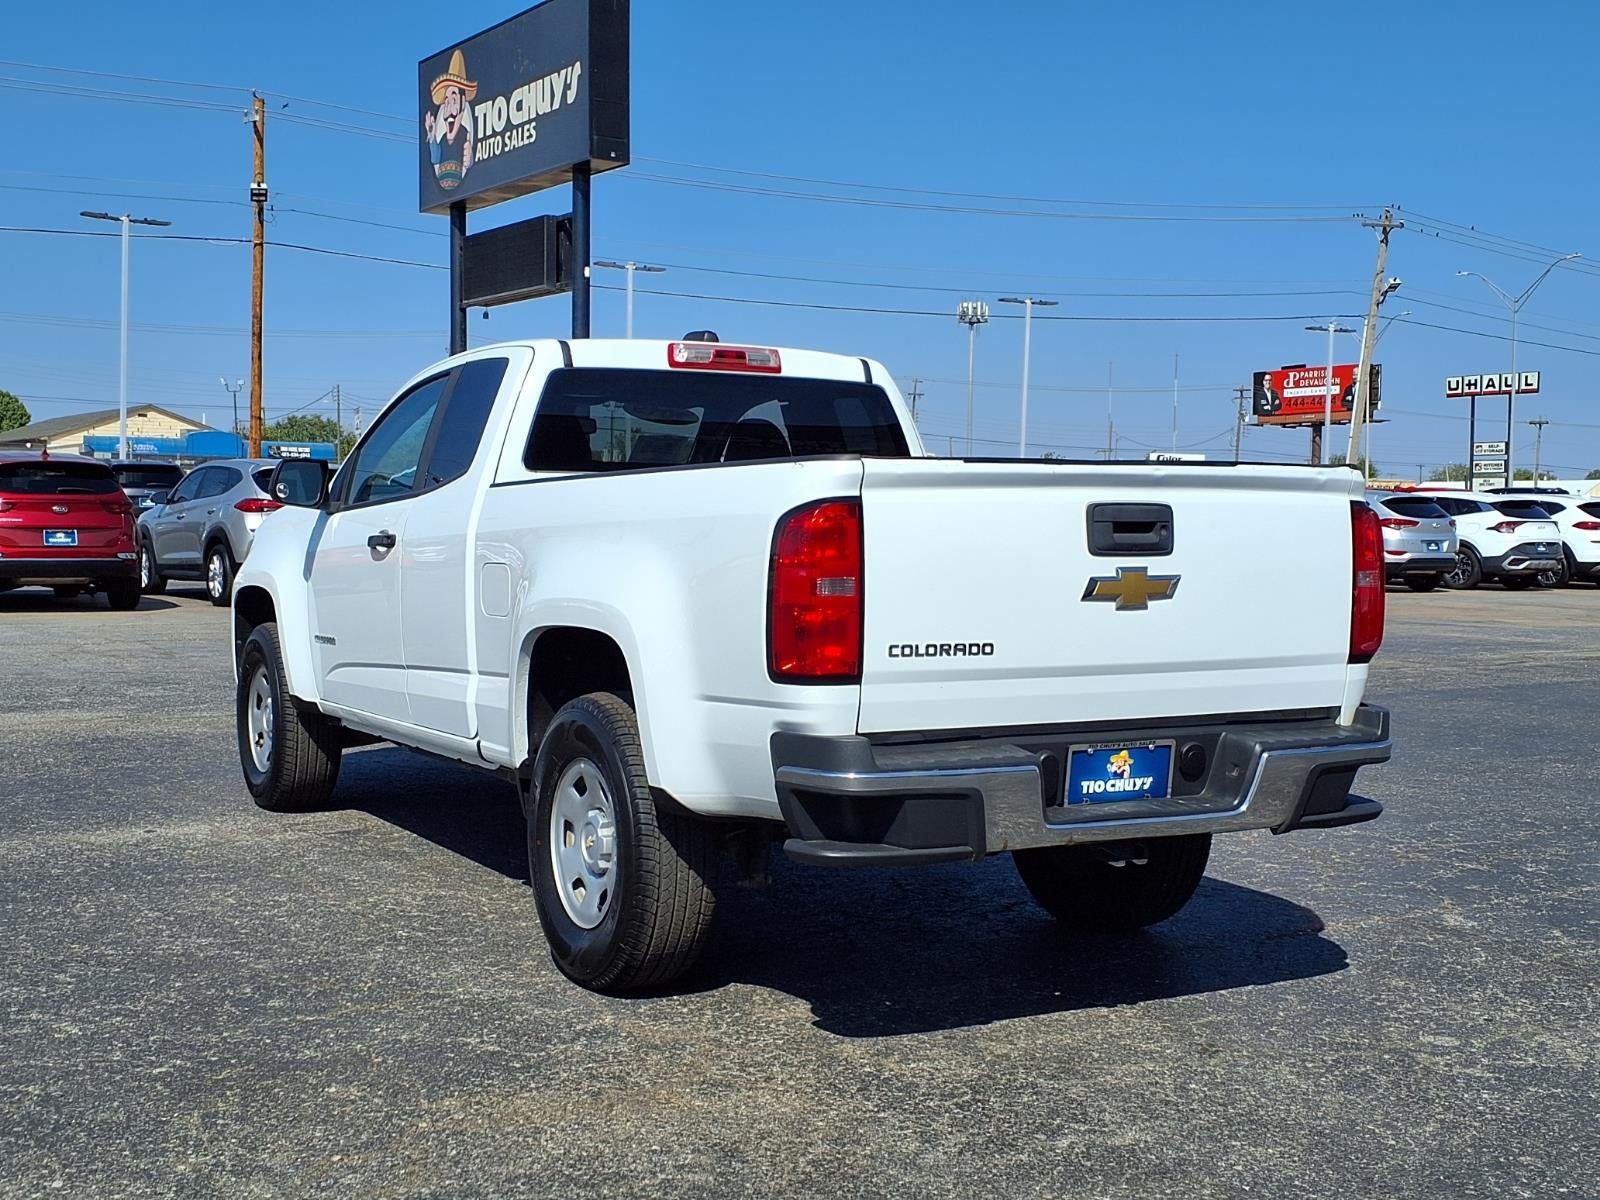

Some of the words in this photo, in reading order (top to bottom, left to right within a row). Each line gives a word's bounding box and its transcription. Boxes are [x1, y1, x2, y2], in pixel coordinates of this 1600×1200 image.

[475, 96, 507, 139] TIO
[509, 61, 581, 125] CHUY'S
[475, 135, 502, 162] AUTO
[504, 121, 536, 152] SALES
[888, 643, 994, 658] COLORADO
[1081, 780, 1105, 794] TIO
[1106, 776, 1153, 792] CHUY'S
